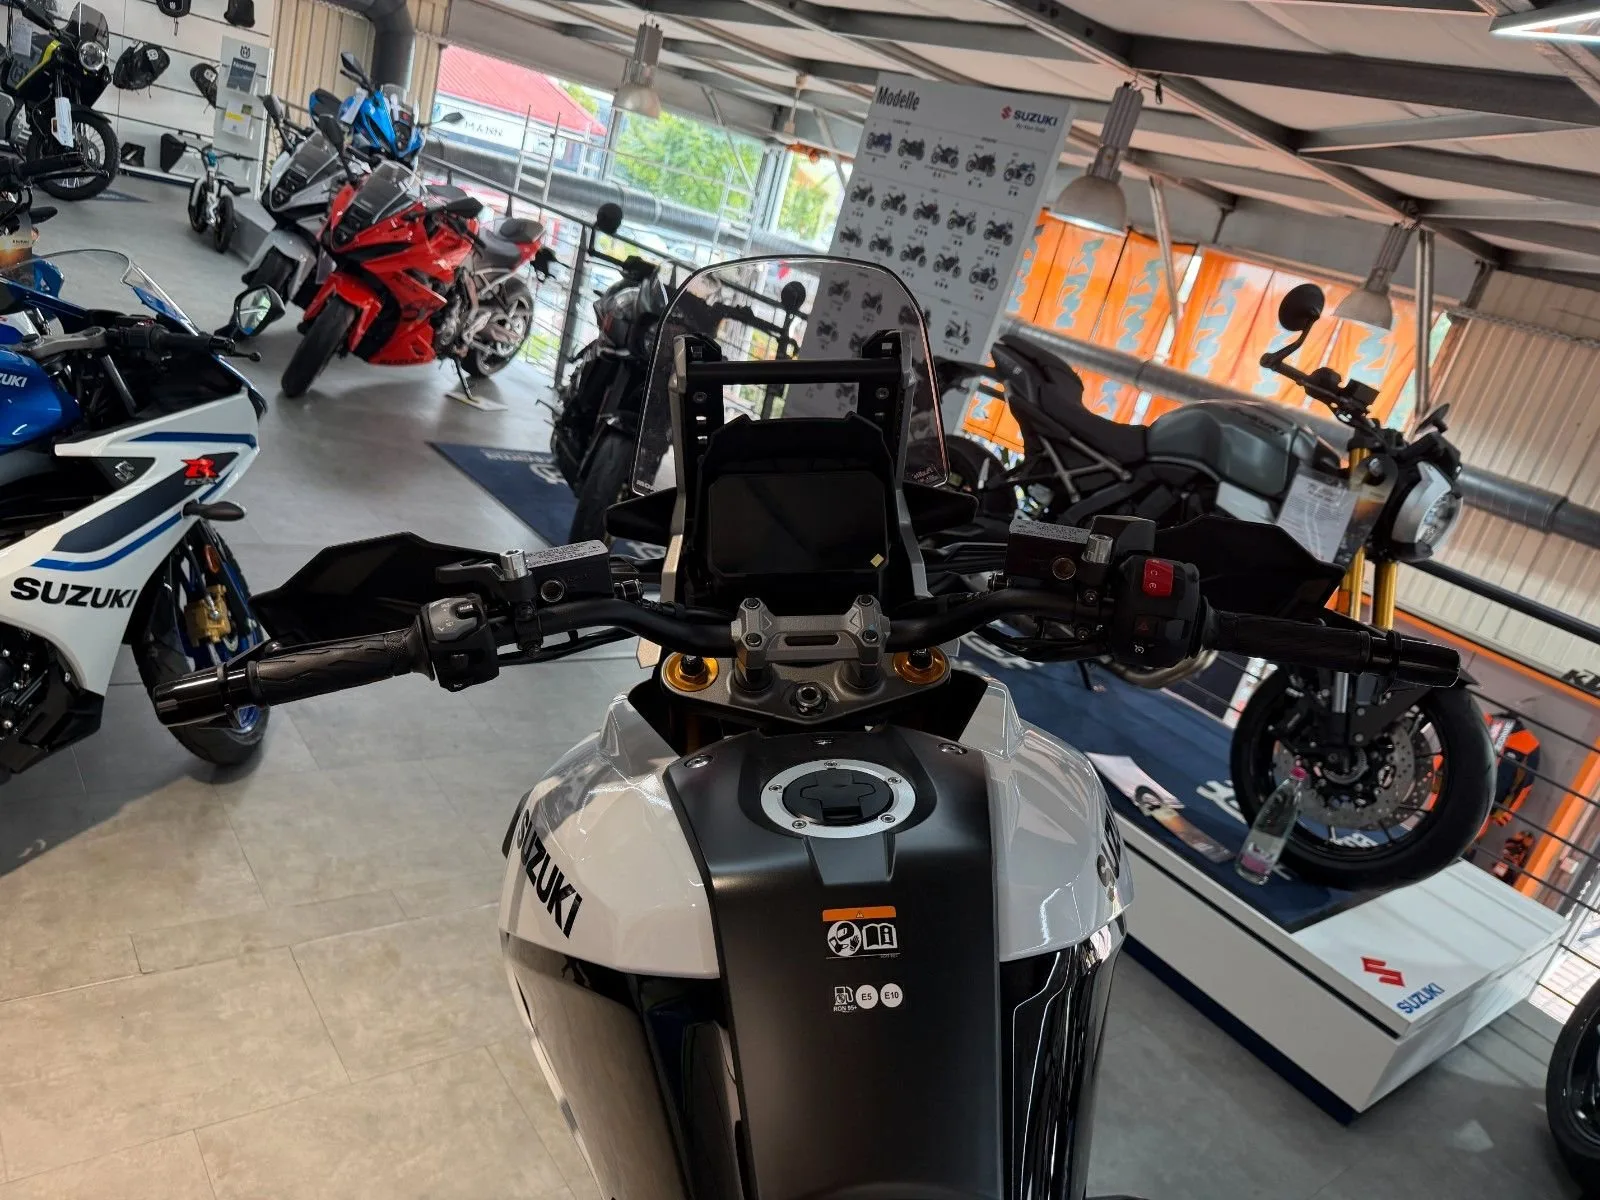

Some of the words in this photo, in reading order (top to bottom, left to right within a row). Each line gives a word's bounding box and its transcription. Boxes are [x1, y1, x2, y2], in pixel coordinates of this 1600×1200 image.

[876, 86, 920, 111] Modelle
[1013, 109, 1058, 127] SUZUKI
[10, 576, 139, 609] SUZUKI
[516, 808, 583, 939] SUZUKI
[861, 993, 873, 1001] E5
[884, 991, 900, 1000] E10
[1396, 982, 1446, 1014] SUZUKI
